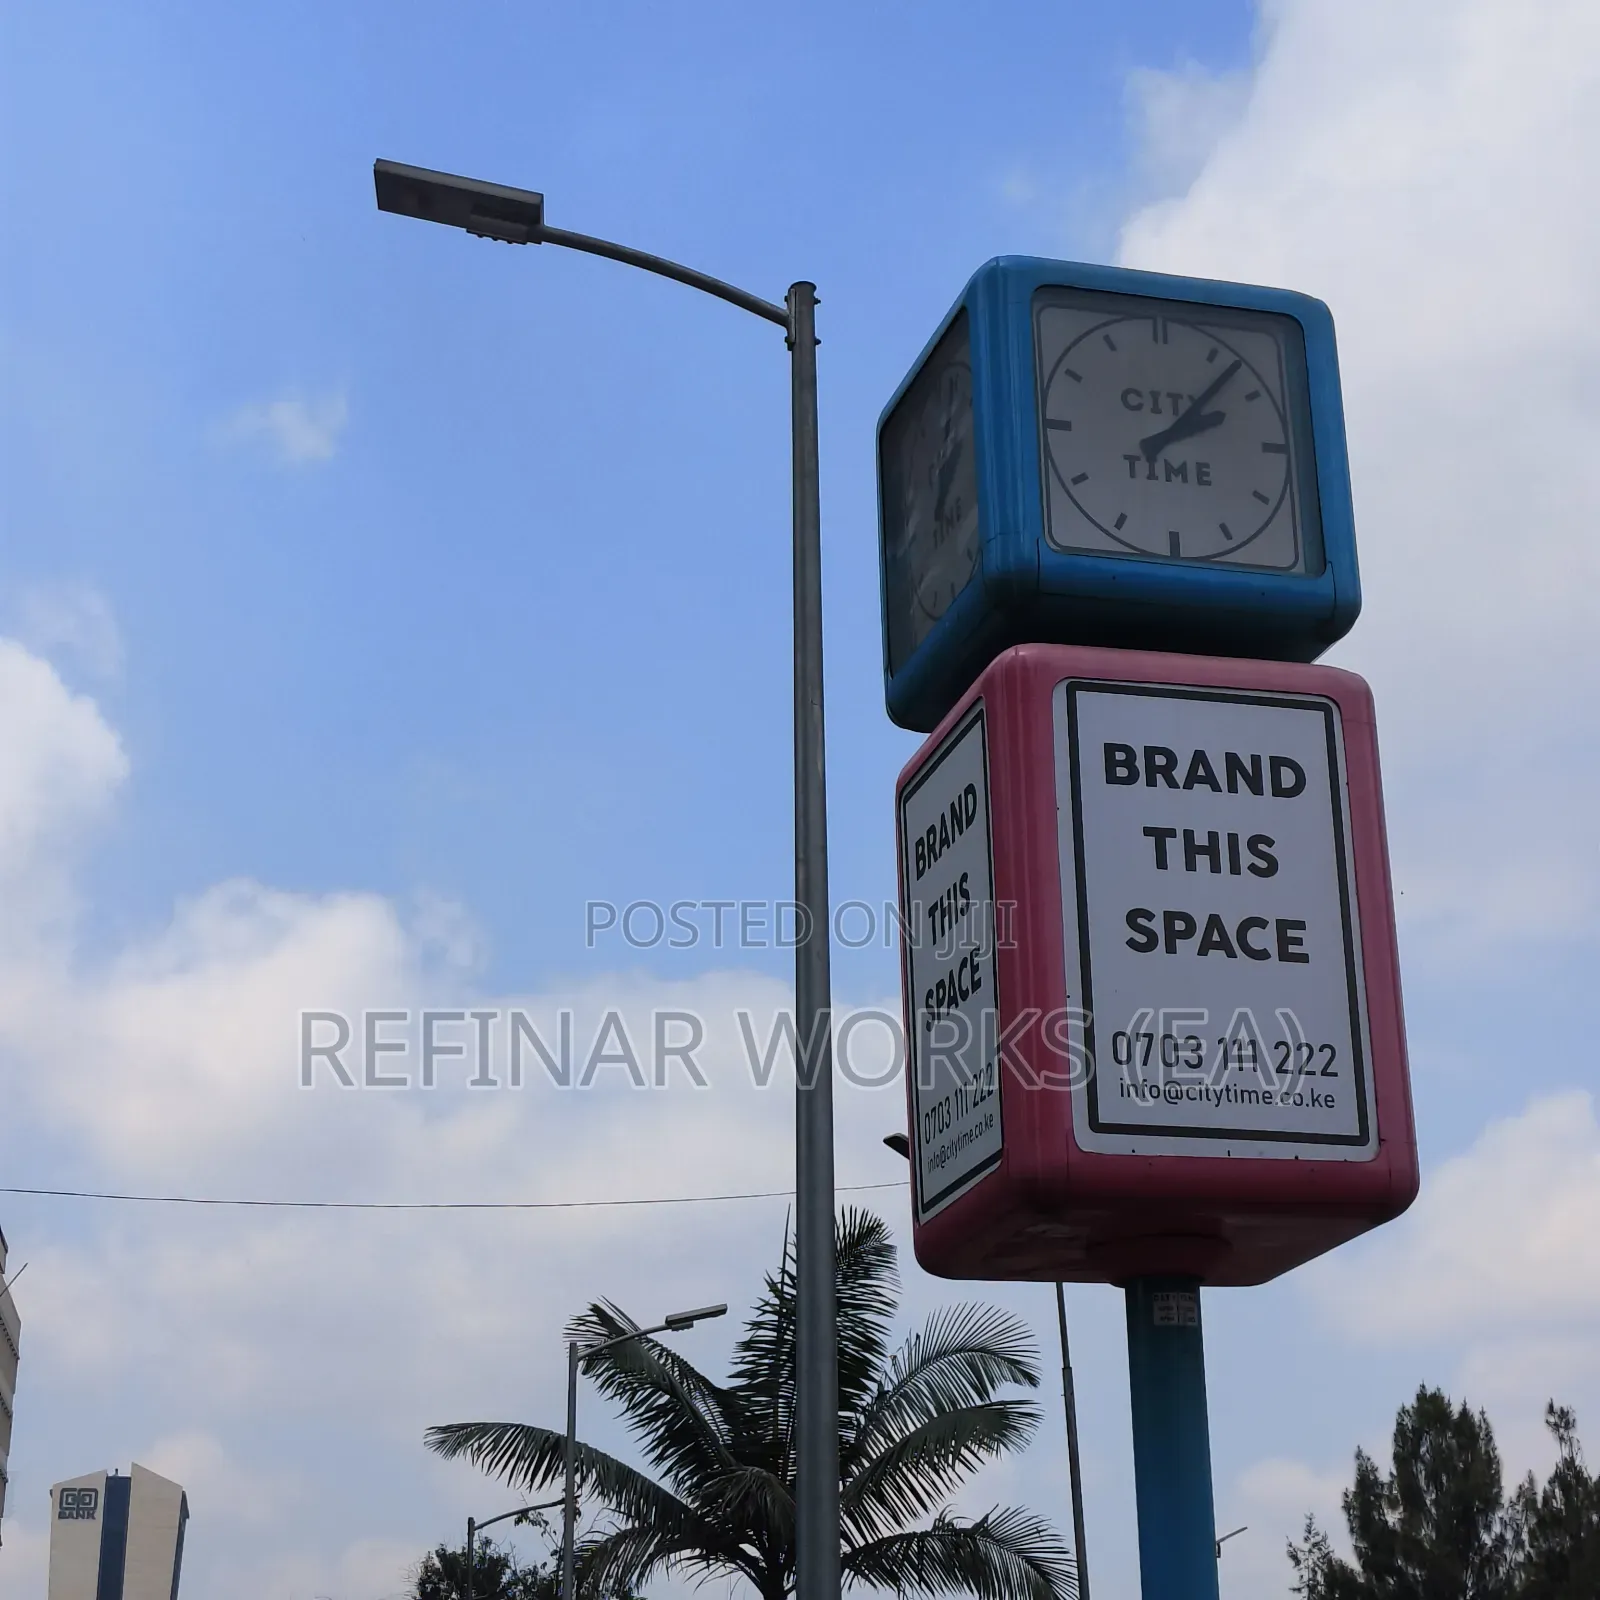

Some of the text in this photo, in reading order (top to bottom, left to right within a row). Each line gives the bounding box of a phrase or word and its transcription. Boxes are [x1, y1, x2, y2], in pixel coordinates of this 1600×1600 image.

[1122, 454, 1212, 486] TIME
[1104, 742, 1307, 798] BRAND
[914, 782, 978, 881] BRAND
[1143, 826, 1279, 878] THIS
[928, 872, 971, 946] THIS
[1125, 908, 1310, 964] SPACE
[925, 946, 982, 1032] SPACE
[1112, 1031, 1339, 1077] 0703 111 222
[924, 1062, 994, 1144] 0703 111 222
[1119, 1078, 1336, 1109] info@citytime.co.ke
[926, 1112, 994, 1174] info@citytime.co.ke
[58, 1510, 96, 1520] BANK
